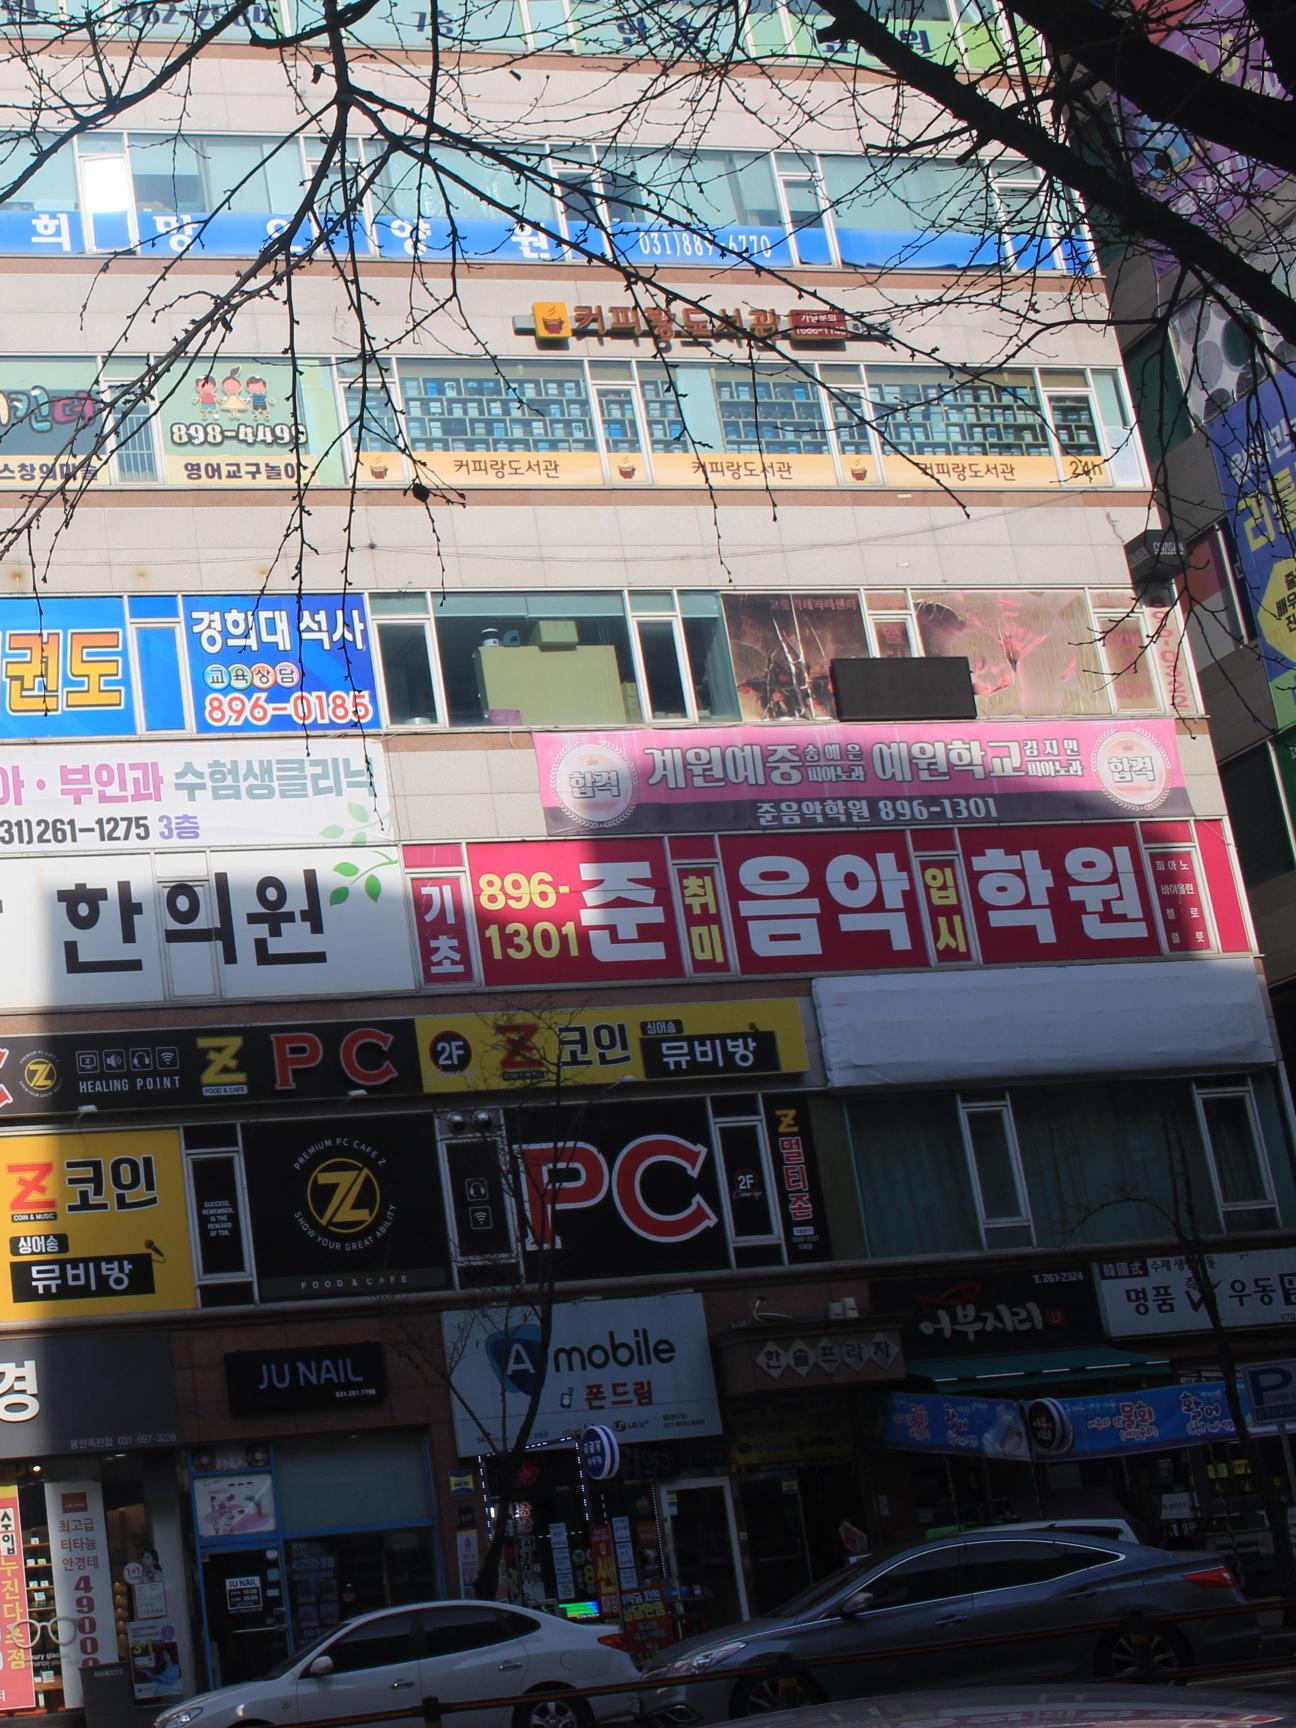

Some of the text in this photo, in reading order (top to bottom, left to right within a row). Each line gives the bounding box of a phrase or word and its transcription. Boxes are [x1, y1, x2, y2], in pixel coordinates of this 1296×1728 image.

[573, 304, 780, 346] 커피랑도서관
[454, 458, 560, 480] 커피랑도서관
[691, 460, 792, 480] 커피랑도서관
[920, 462, 1015, 481] 커피랑도서관
[191, 609, 366, 653] 경희대 석사
[207, 666, 297, 685] 교육상담
[206, 692, 373, 726] 896-0185
[59, 762, 164, 806] 부인과
[174, 757, 375, 802] 수험생클리닉
[569, 769, 621, 798] 합격
[644, 744, 803, 788] 계원예중
[872, 740, 1024, 782] 예원학교
[1108, 756, 1156, 782] 합격
[807, 760, 1083, 782] 피아노과 피아노과
[757, 797, 998, 825] 준음악학원 896-1301
[158, 814, 200, 840] 3층
[1156, 859, 1190, 872] 피아노
[1160, 883, 1195, 896] 바이올린
[682, 875, 726, 964] 취미
[924, 867, 968, 953] 입시
[421, 884, 465, 975] 기초
[485, 921, 580, 961] 1301
[270, 1028, 399, 1090] PC
[437, 1042, 467, 1066] 2F
[556, 1022, 633, 1070] 코인
[662, 1037, 758, 1070] 뮤비방
[79, 1078, 129, 1094] HEALING
[294, 1137, 333, 1170] PREMIUM
[336, 1137, 350, 1147] PC
[354, 1139, 378, 1160] CAFE
[65, 1155, 160, 1213] 코인
[513, 1133, 719, 1250] PC
[13, 1213, 30, 1222] COIN
[38, 1212, 55, 1221] MUSIC
[294, 1203, 397, 1252] SHOW YOUR GREAT ABILITY
[19, 1235, 60, 1254] 싱어송
[31, 1260, 133, 1294] 뮤비방
[1152, 1258, 1172, 1273] 수제
[301, 1274, 408, 1290] FOOD CAFE
[1125, 1276, 1277, 1316] 명품 우동
[554, 1328, 676, 1373] mobile
[764, 1340, 891, 1370] 한솔프라자
[258, 1357, 363, 1391] JU NAIL
[1248, 1367, 1293, 1406] P
[585, 1380, 654, 1410] 폰드림
[59, 1518, 95, 1533] 최고급
[61, 1537, 97, 1552] 티타늄
[62, 1555, 99, 1571] 안경테
[239, 1577, 259, 1587] NAIL
